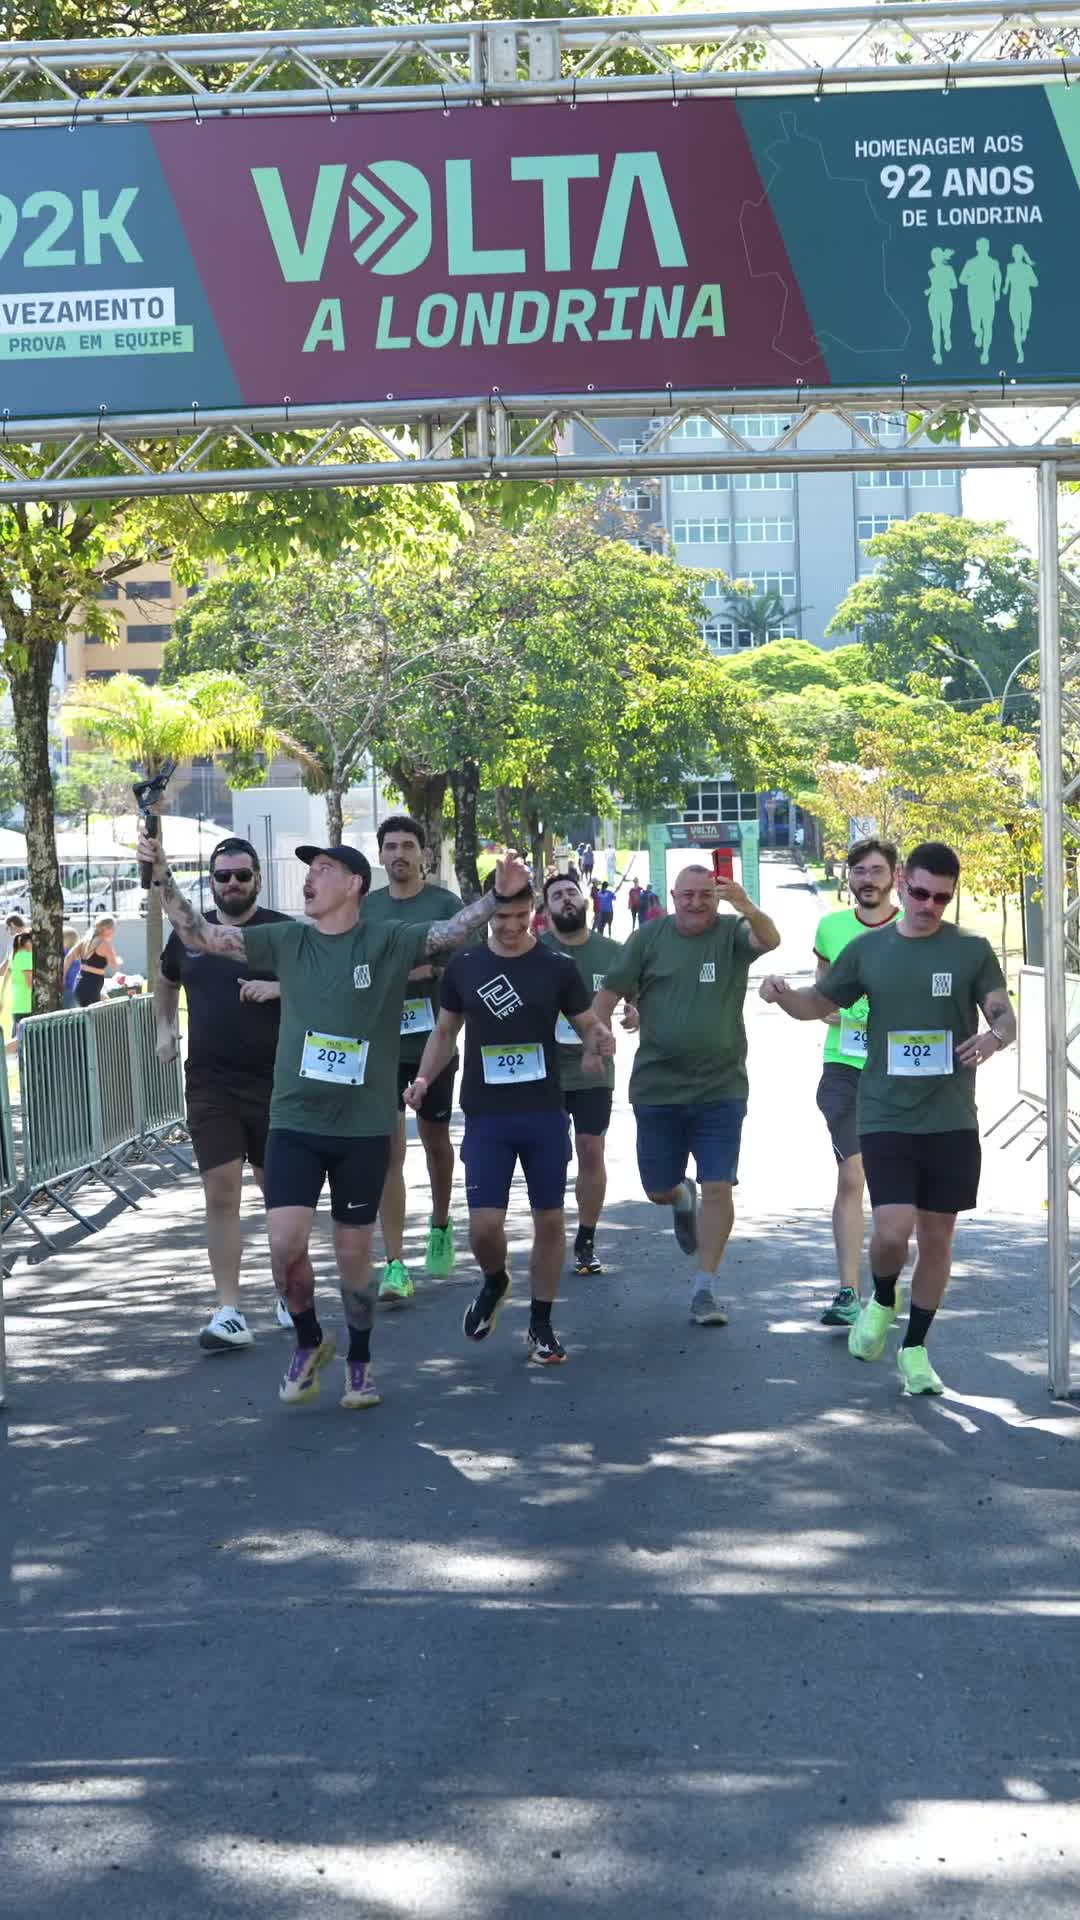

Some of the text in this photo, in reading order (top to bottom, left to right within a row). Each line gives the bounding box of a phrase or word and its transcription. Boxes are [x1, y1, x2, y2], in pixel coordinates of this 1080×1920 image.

[855, 135, 1023, 158] HOMENAGEM AOS
[880, 163, 1035, 199] 92 ANOS
[250, 151, 688, 283] VOLTA
[902, 205, 1043, 227] DE LONDRINA
[302, 284, 726, 353] A LONDRINA
[9, 331, 183, 353] PROVA EM EQUIPE
[317, 1048, 346, 1064] 202
[497, 1054, 524, 1067] 202
[903, 1045, 931, 1057] 202
[327, 1063, 334, 1072] 2
[914, 1058, 920, 1067] 6
